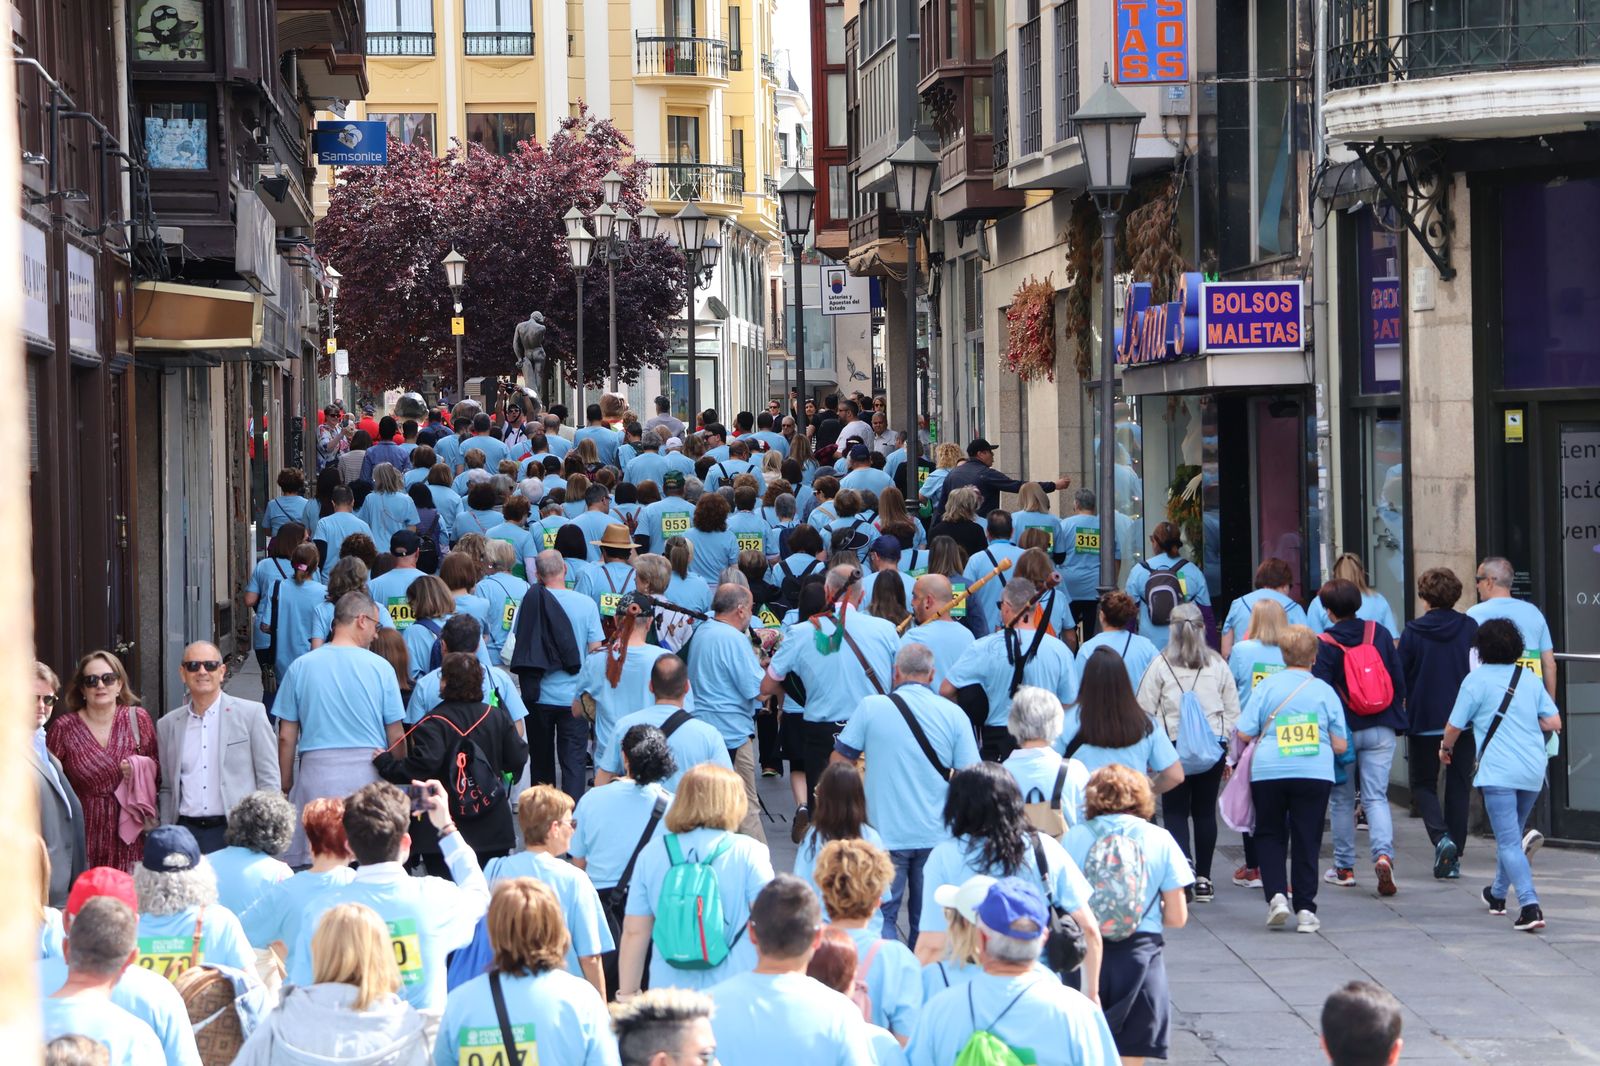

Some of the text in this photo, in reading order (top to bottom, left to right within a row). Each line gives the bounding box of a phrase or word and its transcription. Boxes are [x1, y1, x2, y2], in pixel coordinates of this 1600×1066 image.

[1121, 0, 1150, 78] TAS
[321, 151, 382, 162] Samsonite
[1213, 291, 1293, 315] BOLSOS
[1208, 320, 1299, 345] MALETAS
[1561, 440, 1600, 458] ien
[665, 519, 688, 531] 953
[738, 540, 760, 551] 952
[1077, 535, 1098, 547] 313
[1281, 724, 1316, 743] 494
